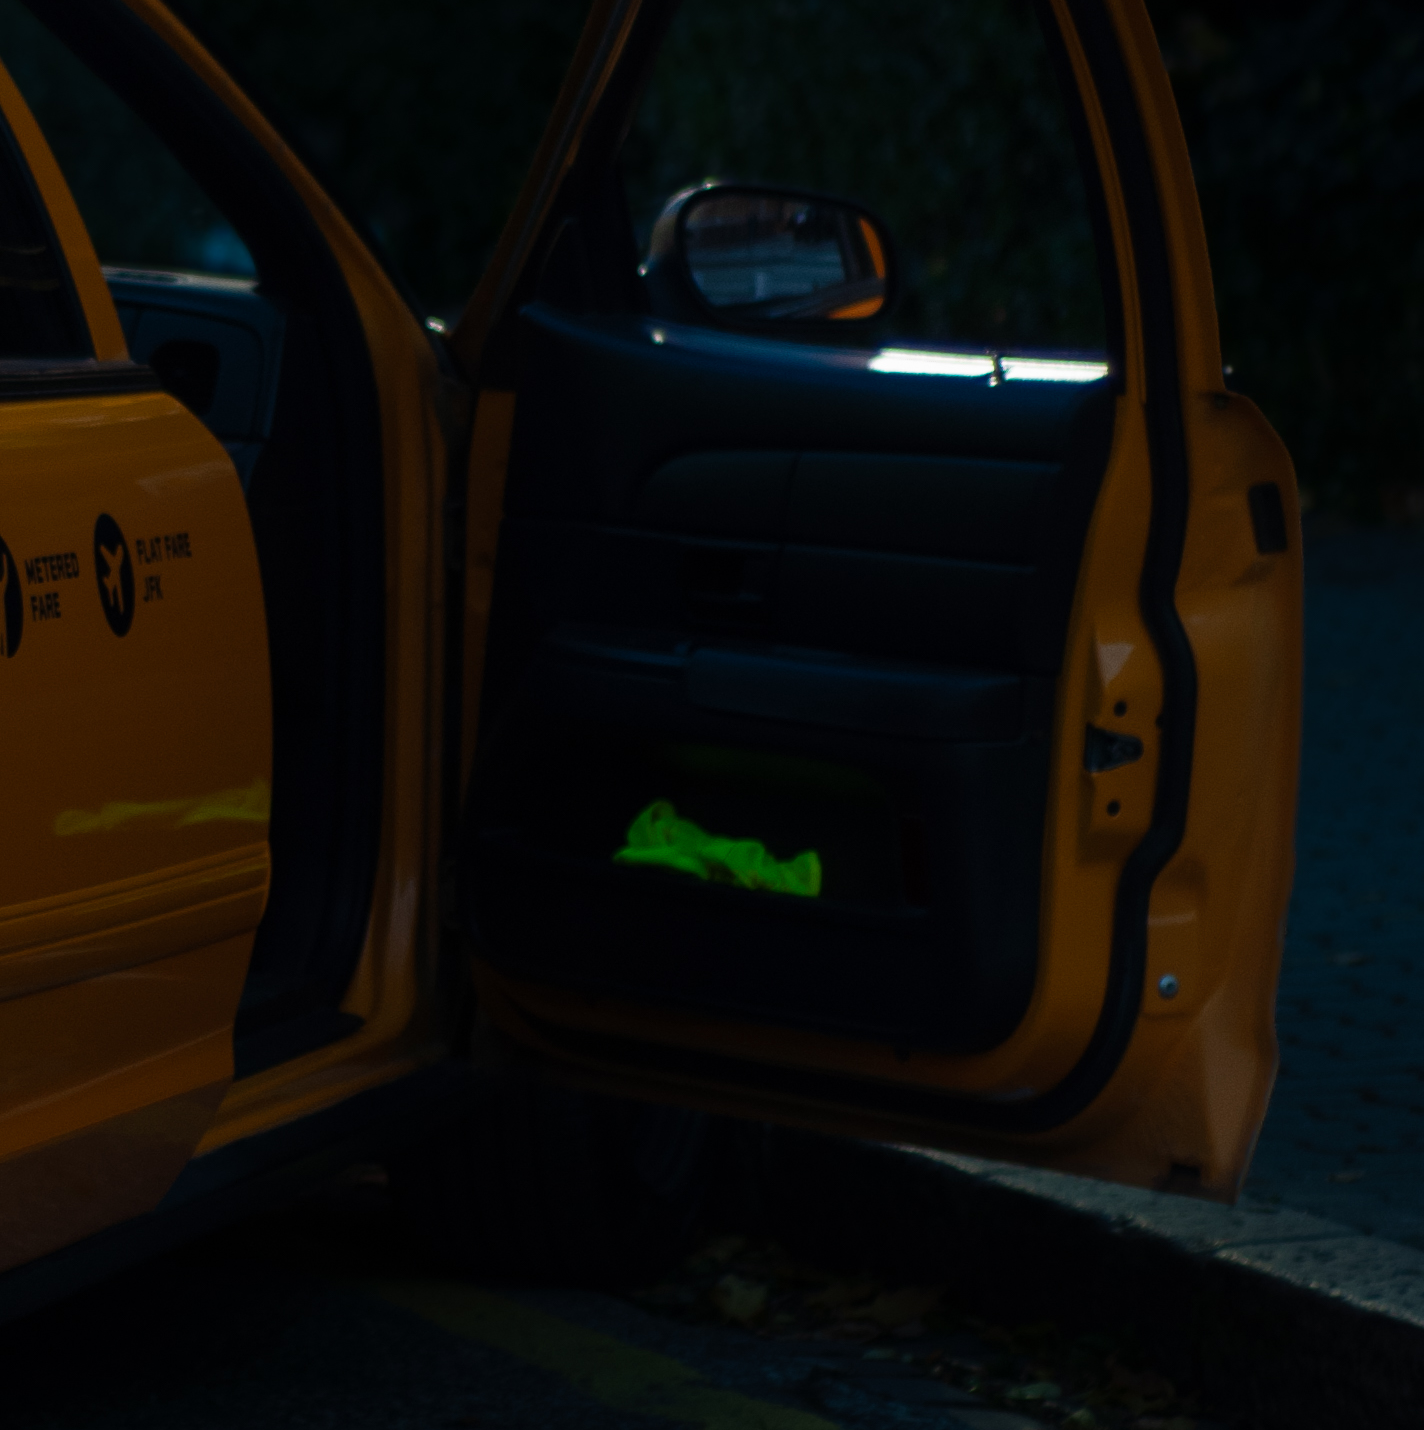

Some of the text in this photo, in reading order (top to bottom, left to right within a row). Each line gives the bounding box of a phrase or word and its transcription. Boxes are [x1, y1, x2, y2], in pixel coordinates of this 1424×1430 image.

[136, 533, 192, 564] FLAT FARE
[25, 553, 79, 584] METERED
[143, 575, 163, 602] JFK
[29, 592, 62, 622] FARE
